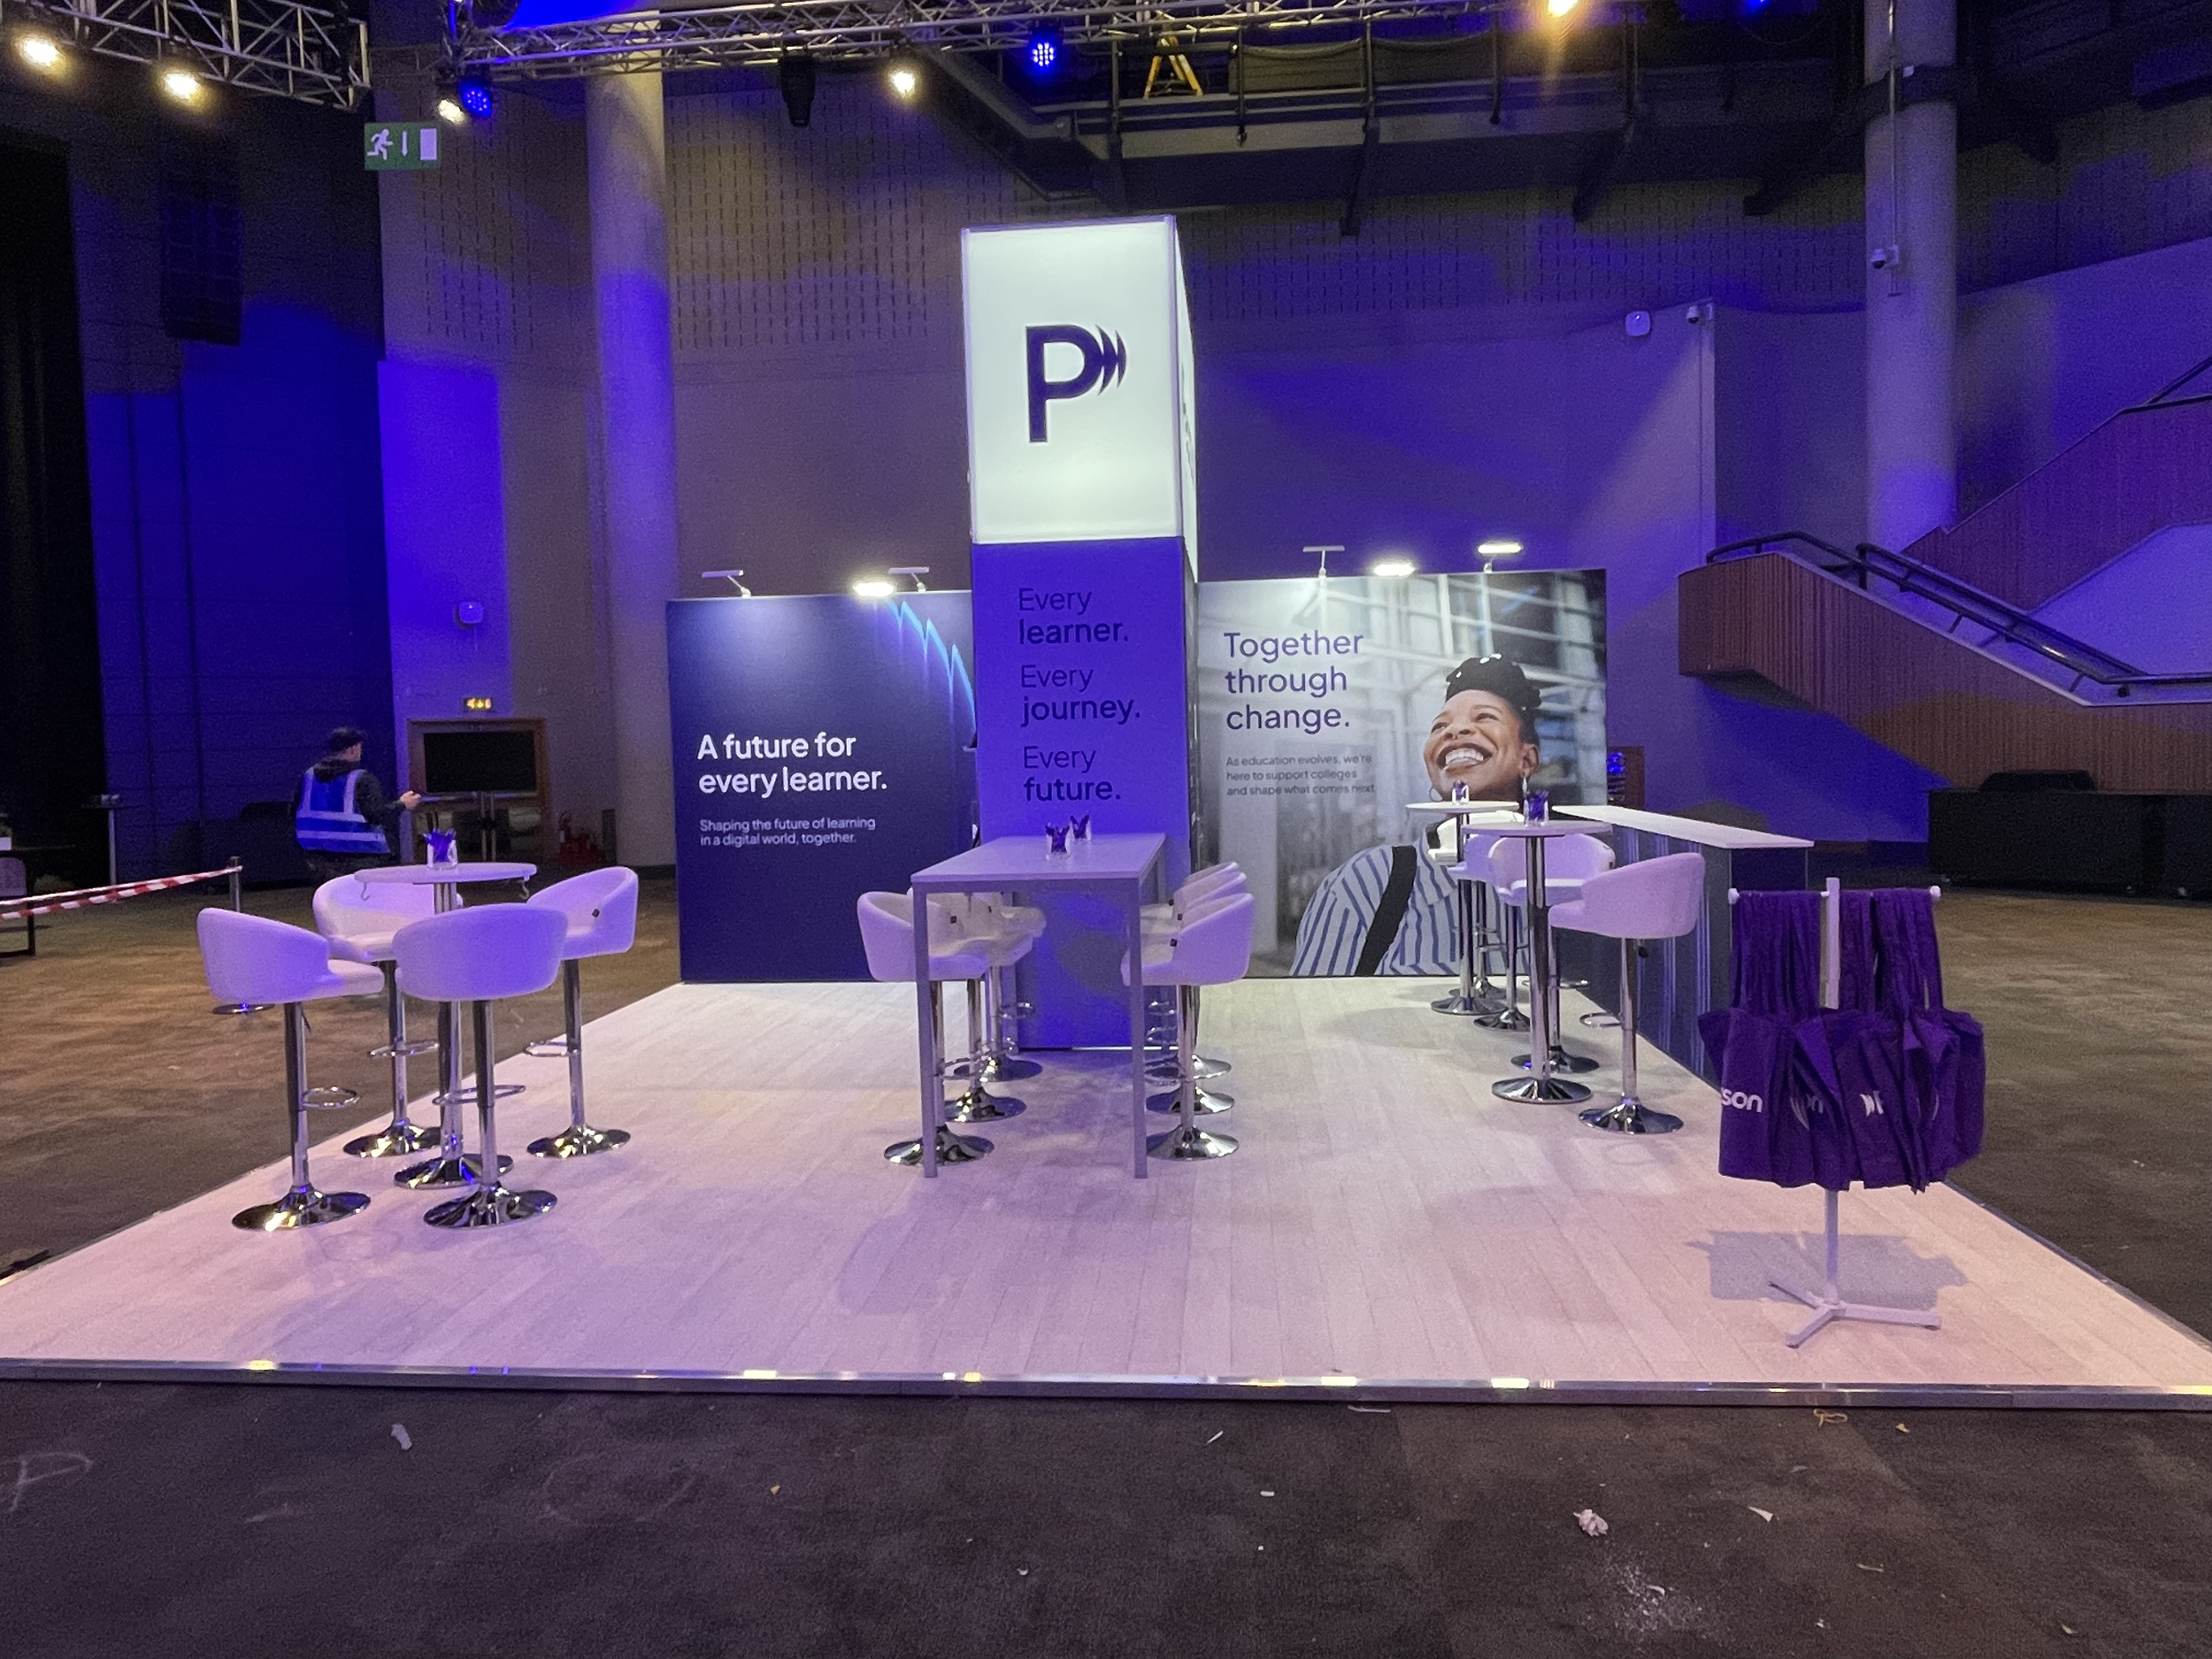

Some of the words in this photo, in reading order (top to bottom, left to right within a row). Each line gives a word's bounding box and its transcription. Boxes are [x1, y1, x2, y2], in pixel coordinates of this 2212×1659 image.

[1018, 587, 1093, 616] Every
[1019, 618, 1128, 645] learner.
[1223, 629, 1364, 664] Together
[1020, 664, 1094, 693] Every
[1225, 664, 1348, 698] through
[1020, 695, 1141, 728] journey.
[1225, 703, 1350, 735] change.
[697, 733, 718, 759] A
[722, 733, 809, 759] future
[814, 731, 856, 757] for
[1023, 745, 1096, 774] Every
[1225, 756, 1240, 767] As
[1240, 756, 1296, 766] education
[1343, 753, 1372, 764] we're
[698, 773, 778, 798] every
[782, 766, 887, 792] learner.
[1023, 776, 1121, 802] future.
[1226, 771, 1251, 781] here
[1252, 771, 1264, 780] to
[1265, 770, 1309, 782] support
[1310, 769, 1357, 781] colleges
[1226, 786, 1248, 796] and
[1249, 786, 1282, 797] shape
[1284, 785, 1310, 795] what
[1312, 785, 1350, 795] comes
[700, 819, 750, 833] Shaping
[751, 818, 772, 831] the
[773, 818, 810, 830] future
[811, 817, 826, 829] of
[826, 816, 876, 831] learning
[700, 834, 711, 847] in
[712, 836, 720, 846] a
[722, 833, 761, 848] digital
[1721, 1087, 1763, 1113] son
